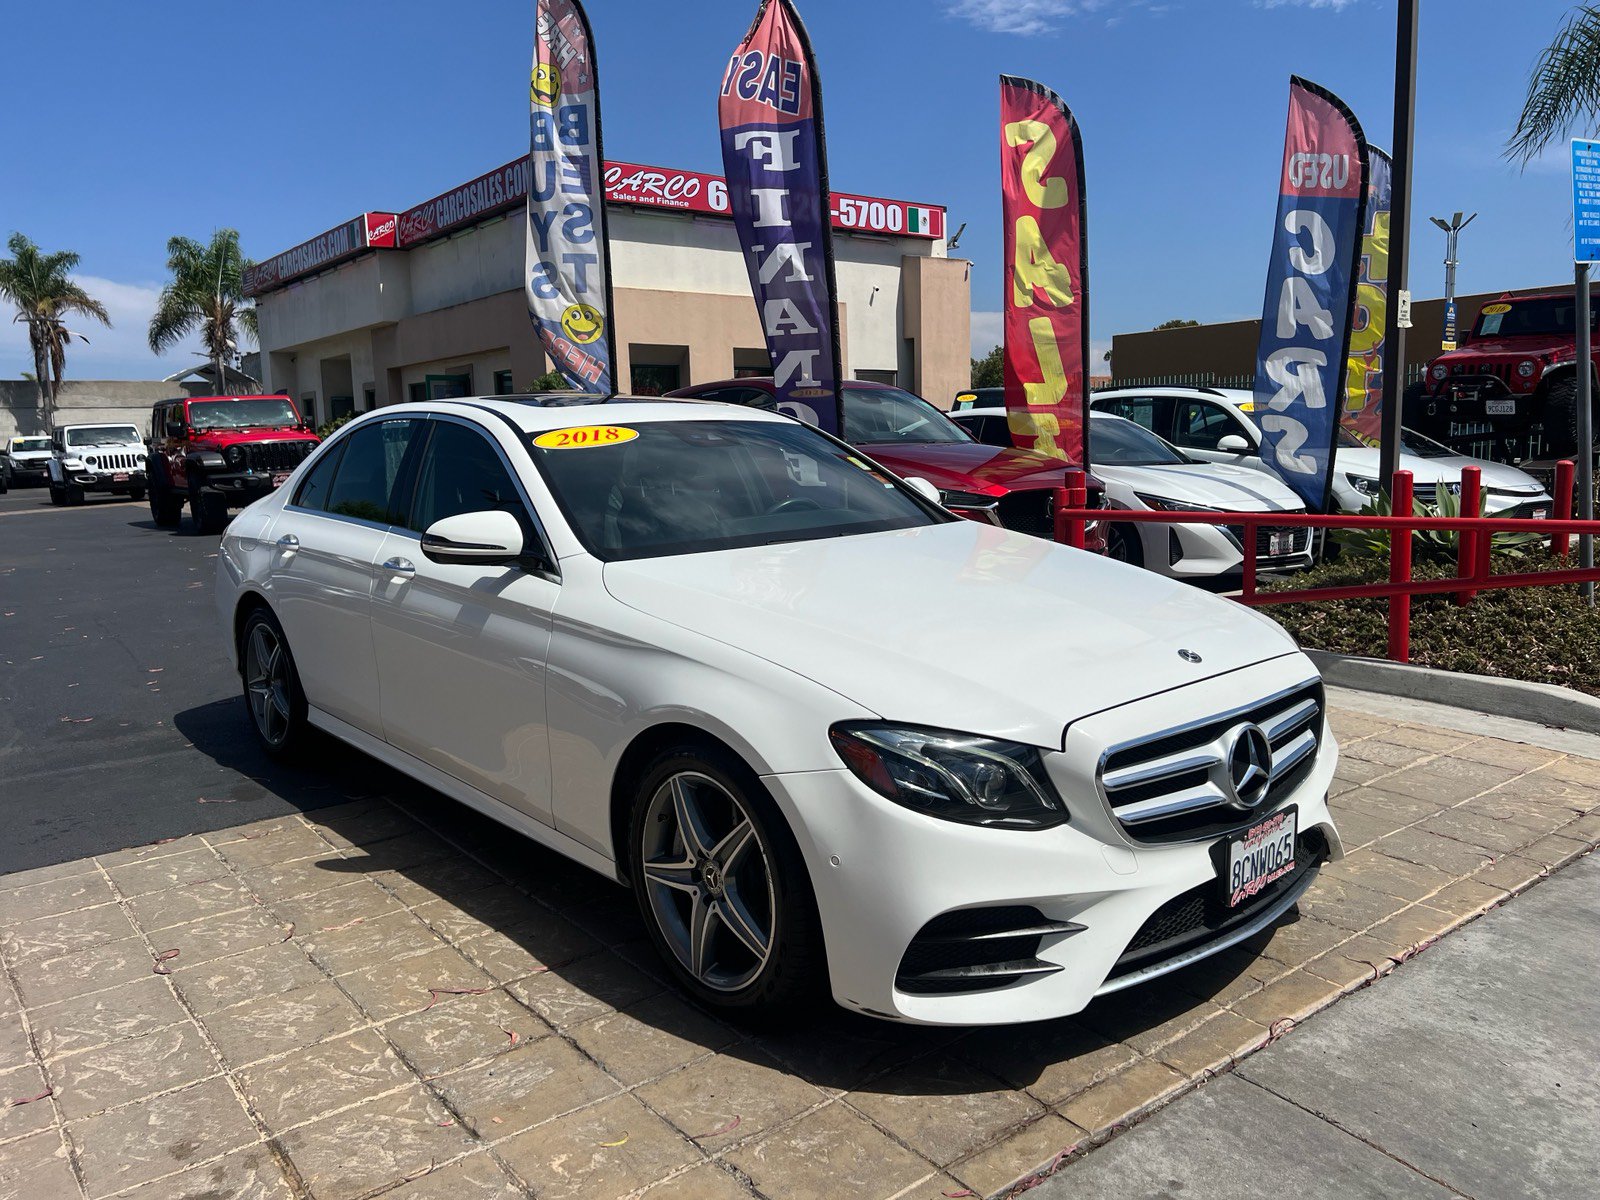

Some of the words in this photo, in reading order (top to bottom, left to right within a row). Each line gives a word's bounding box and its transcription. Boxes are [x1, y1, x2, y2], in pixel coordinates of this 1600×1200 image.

[605, 167, 700, 199] CARCO
[613, 192, 637, 201] Sales
[639, 195, 655, 203] and
[657, 197, 689, 207] Finance
[369, 220, 395, 241] CARCO
[399, 204, 435, 240] CARCO
[278, 228, 349, 280] CARCOSALES.COM
[556, 428, 619, 446] 2018
[1232, 832, 1291, 889] 8CNW065
